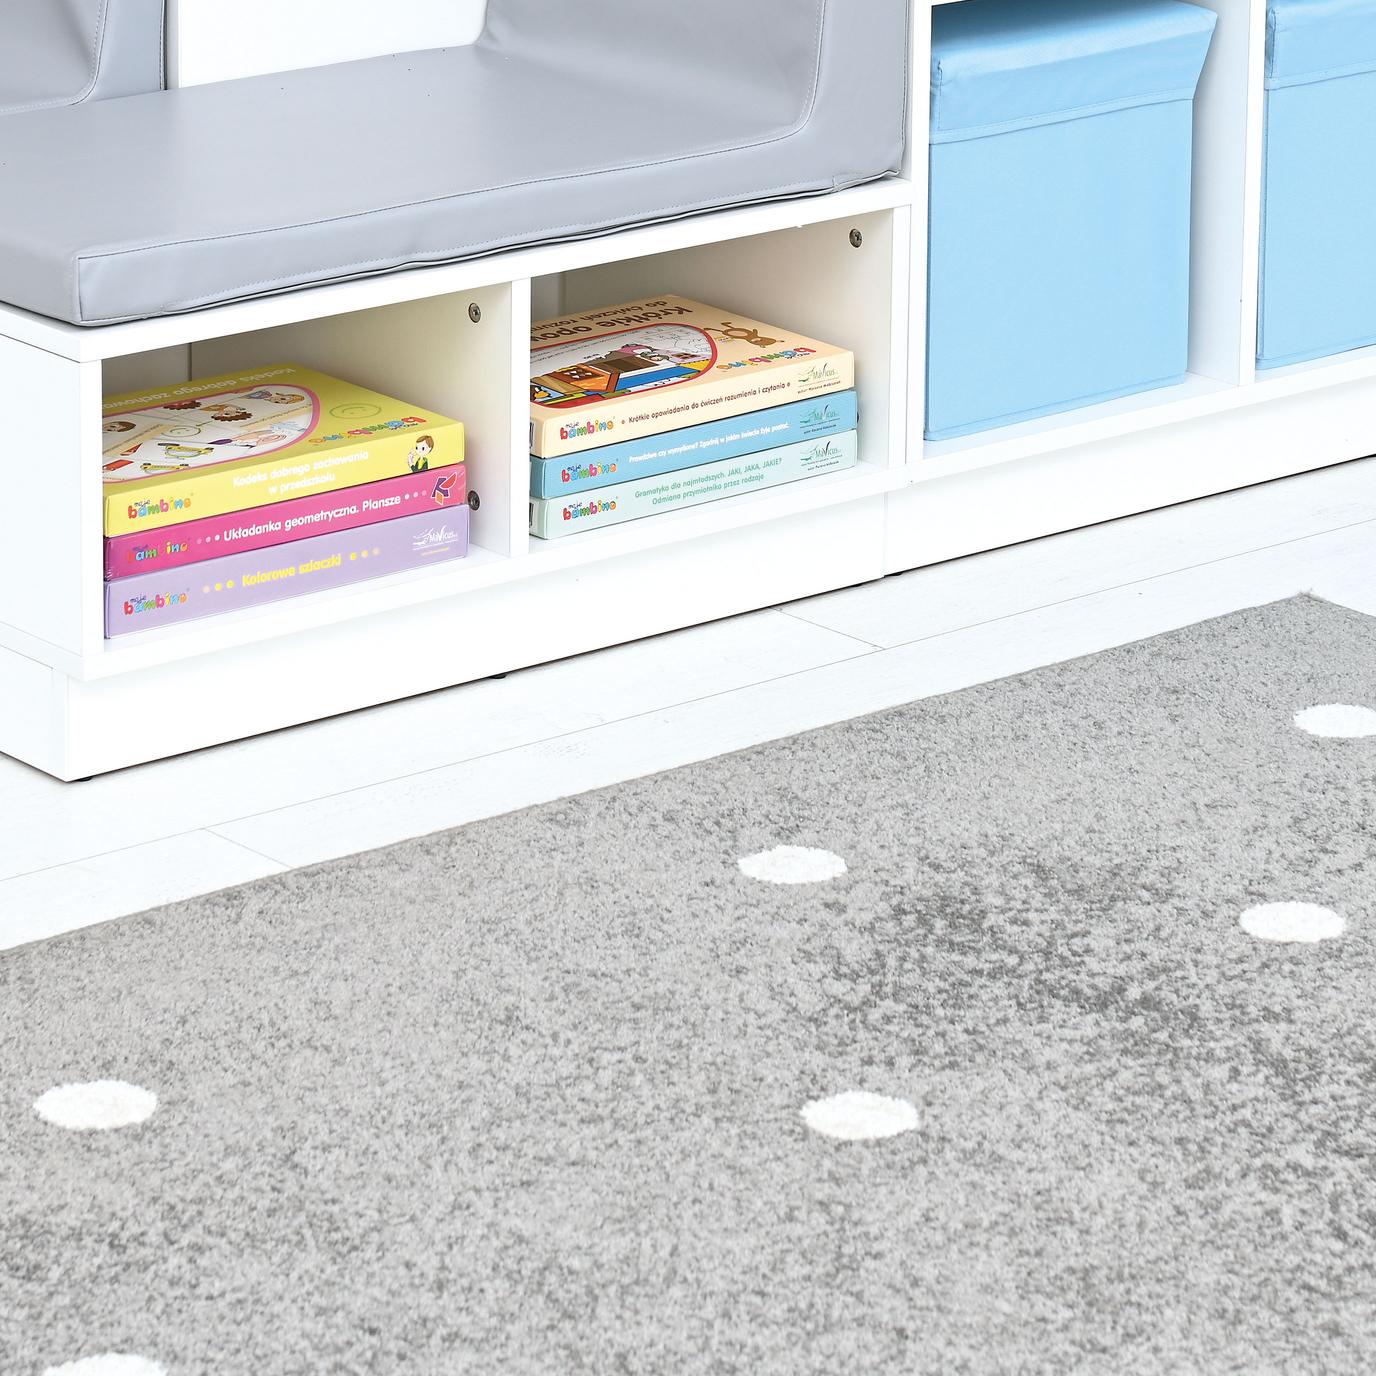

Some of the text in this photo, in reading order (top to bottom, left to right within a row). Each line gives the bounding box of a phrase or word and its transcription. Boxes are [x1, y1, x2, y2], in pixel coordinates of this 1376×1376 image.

[579, 306, 644, 321] ćwiczeń
[645, 300, 668, 308] do
[596, 306, 693, 328] Krótkie
[717, 347, 817, 371] bambino
[628, 414, 650, 424] Krótkie
[651, 404, 690, 420] opowiadania
[691, 402, 699, 410] do
[700, 396, 724, 408] ćwiczeń
[724, 389, 757, 402] rozumienia
[762, 383, 786, 395] czytania
[560, 420, 614, 440] bambino
[629, 452, 657, 464] Prawdziwe
[658, 450, 667, 460] czy
[699, 437, 720, 448] Zgadnij
[725, 431, 741, 443] jakim
[760, 426, 771, 436] żyje
[232, 450, 369, 488] Kodeks dobrego zachowania
[561, 463, 617, 483] bambino
[635, 457, 783, 498] Gramatyka dla najmłodszych. JAKI, JAKA, JAKIE?
[269, 472, 336, 496] w przedszkolu
[652, 474, 765, 505] Odmiana przymiotnika przez rodzaje
[128, 497, 191, 520] bambino
[224, 494, 401, 542] Układanka geometryczna. Plansze
[563, 500, 617, 521] bambino
[127, 541, 188, 564] bambino
[242, 553, 342, 587] Kolorowe szlaczki
[124, 593, 188, 616] bambino
